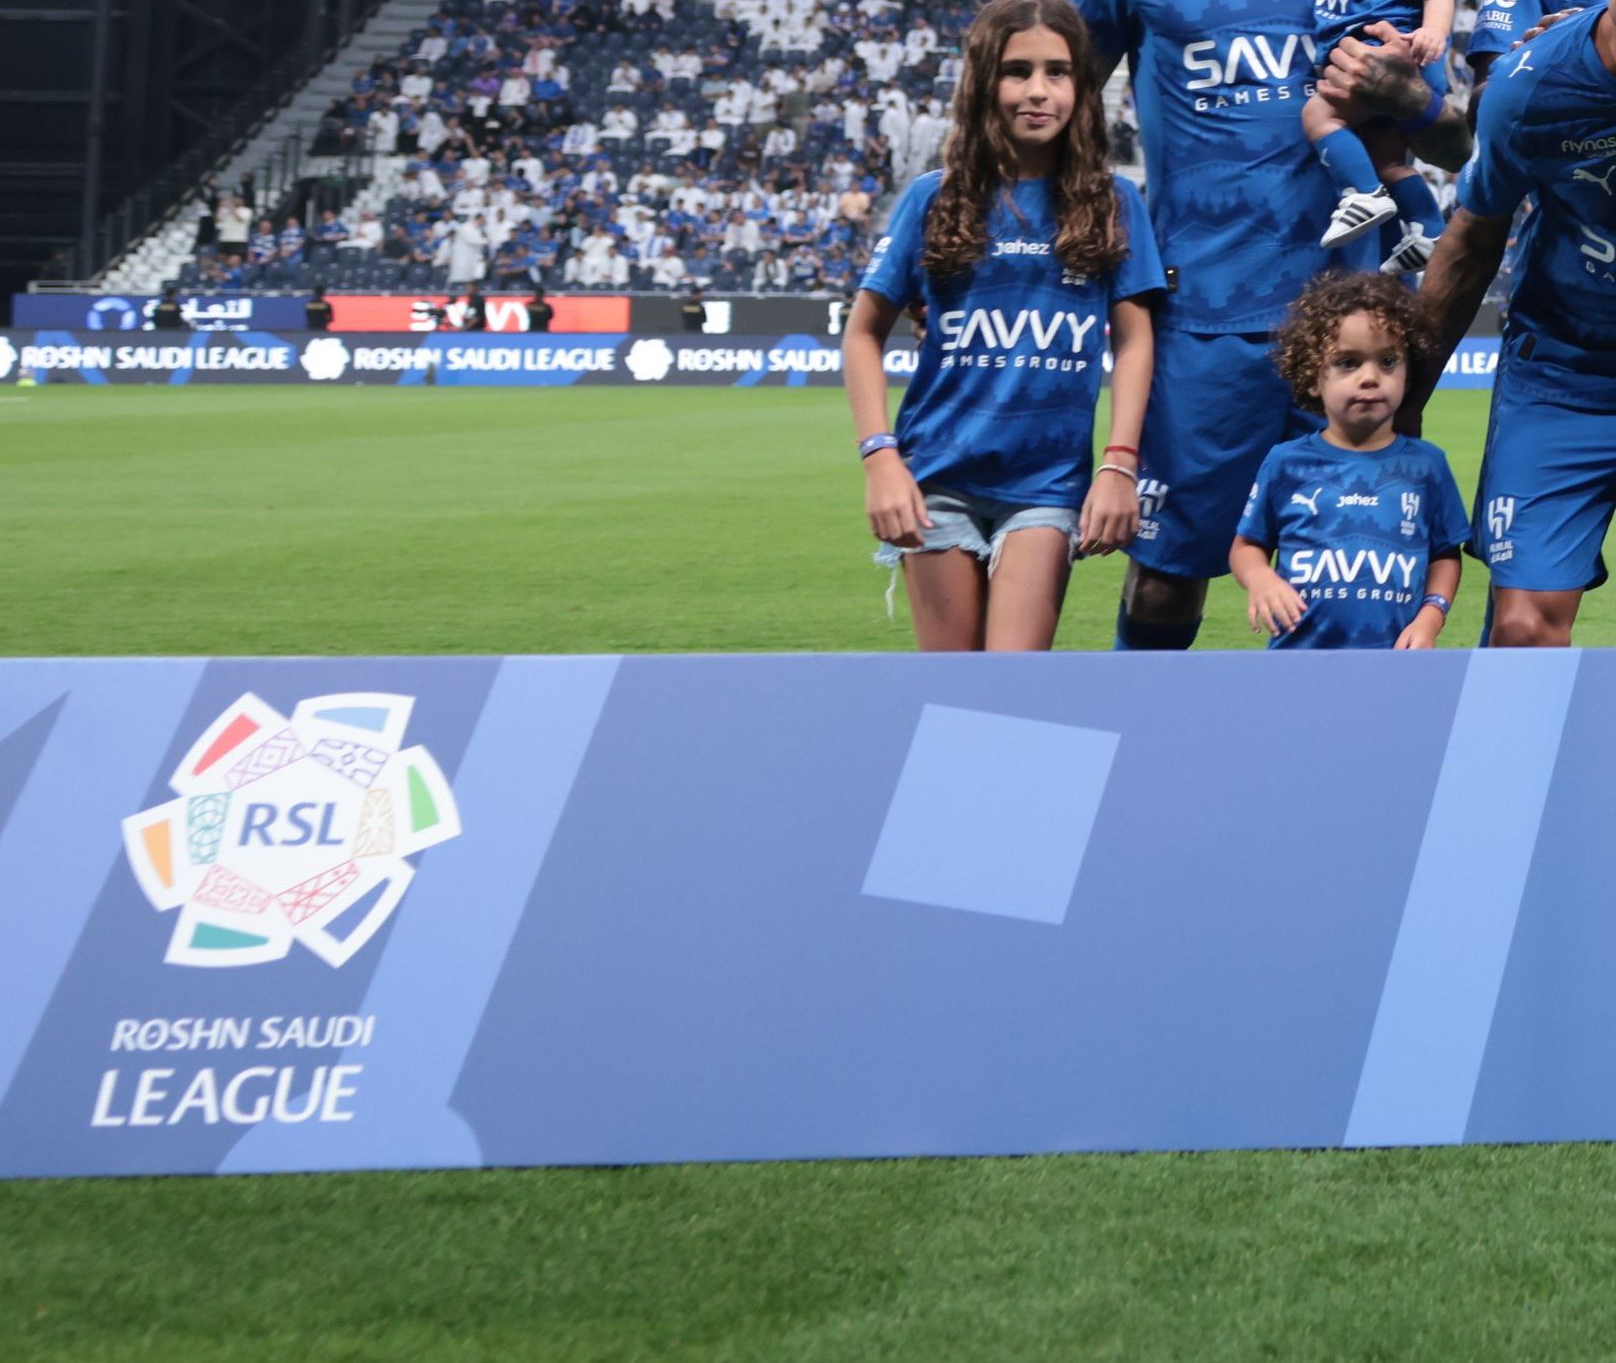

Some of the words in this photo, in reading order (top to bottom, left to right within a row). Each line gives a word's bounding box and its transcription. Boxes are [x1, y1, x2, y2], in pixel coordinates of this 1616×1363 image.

[1195, 86, 1291, 111] GAMES
[939, 309, 1096, 353] SAVVY
[20, 346, 111, 369] ROSHN
[116, 347, 192, 370] SAUDI
[195, 347, 289, 370] LEAGUE
[353, 348, 442, 370] ROSHN
[447, 348, 521, 371] SAUDI
[524, 348, 614, 371] LEAGUE
[677, 349, 763, 371] ROSHN
[768, 349, 841, 372] SAUDI
[1014, 355, 1087, 372] GROUP
[1290, 549, 1416, 588] SAVVY
[1299, 587, 1348, 600] AMES
[1356, 587, 1413, 604] GROUP
[237, 802, 345, 847] RSL
[110, 1016, 251, 1052] ROSHN
[256, 1014, 375, 1050] SAUDI
[90, 1064, 364, 1127] LEAGUE
